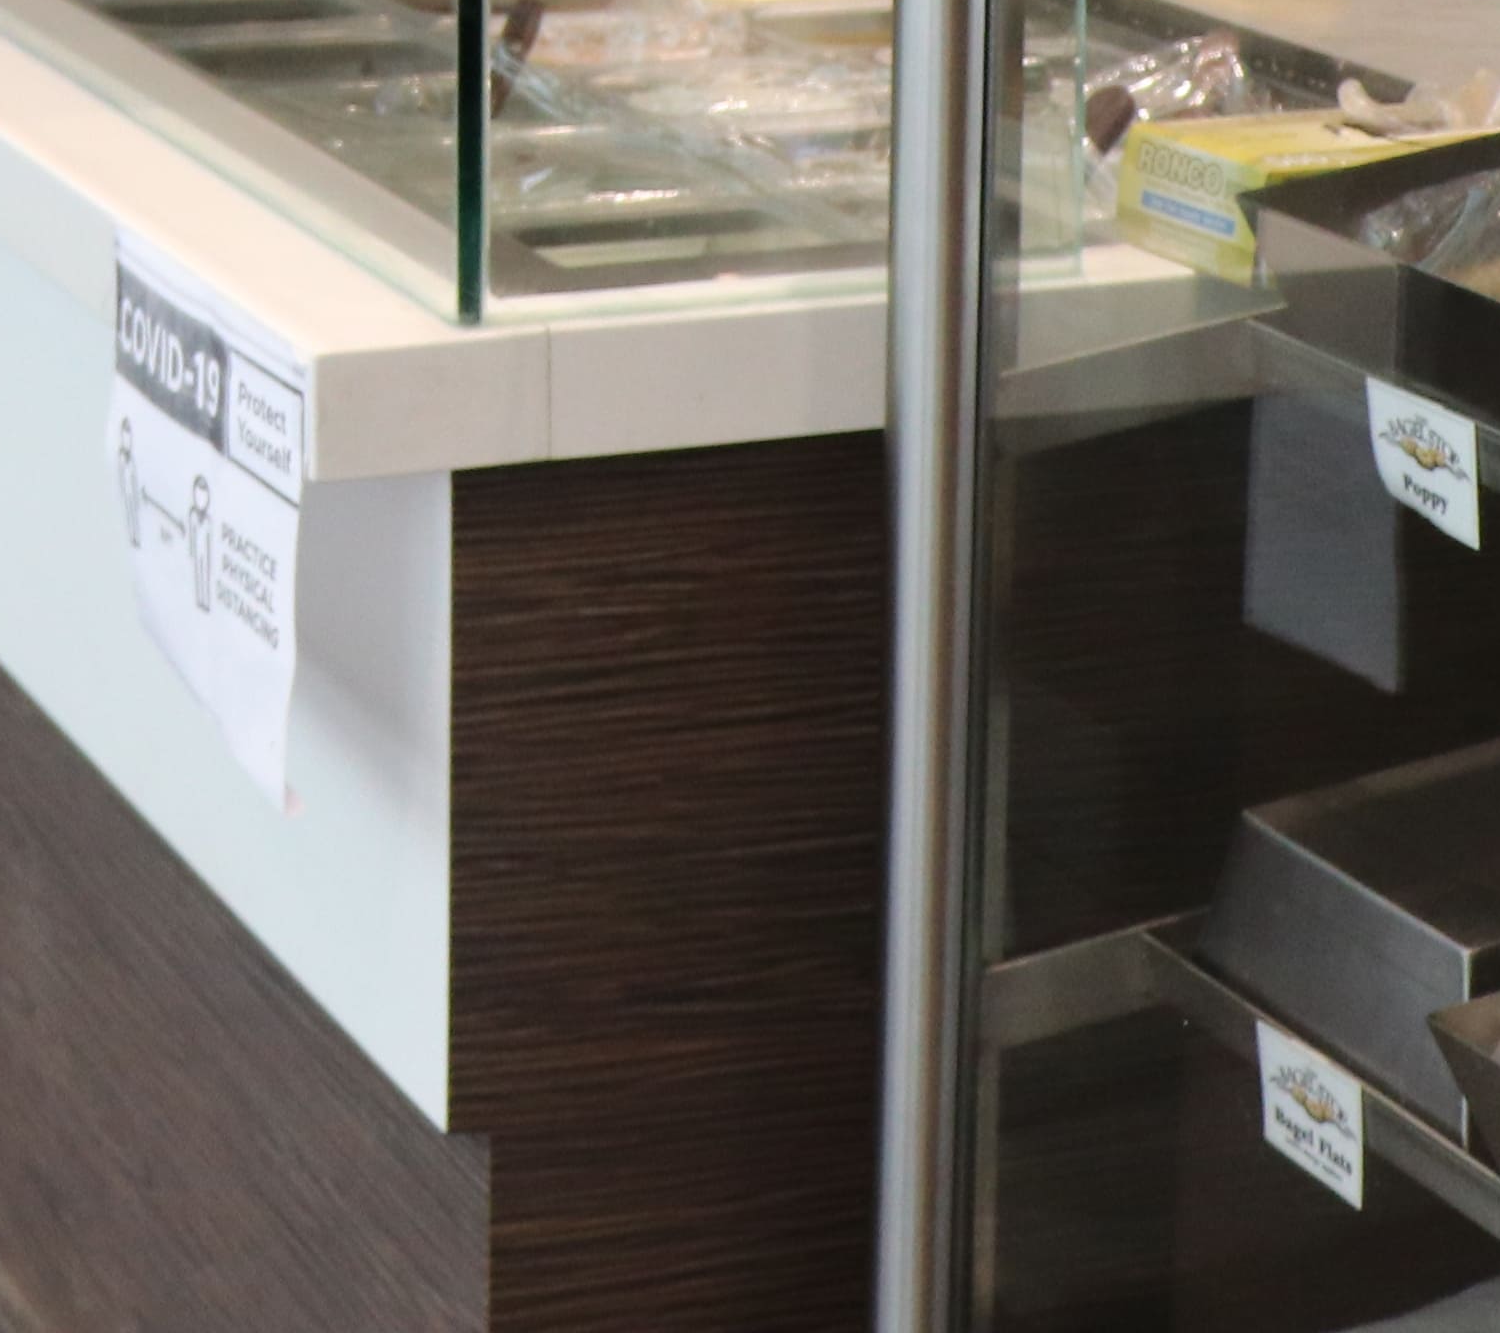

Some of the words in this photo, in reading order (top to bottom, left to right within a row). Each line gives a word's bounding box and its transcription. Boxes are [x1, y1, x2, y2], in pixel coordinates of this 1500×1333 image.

[1136, 139, 1226, 198] RONCO
[119, 296, 221, 418] COVID-19
[237, 382, 287, 434] Protect
[237, 416, 293, 474] Yourself
[1402, 472, 1448, 515] Poppy
[221, 521, 278, 582] PRACTICE
[221, 553, 275, 614] PHYSICAL
[215, 579, 281, 650] DISTANCING
